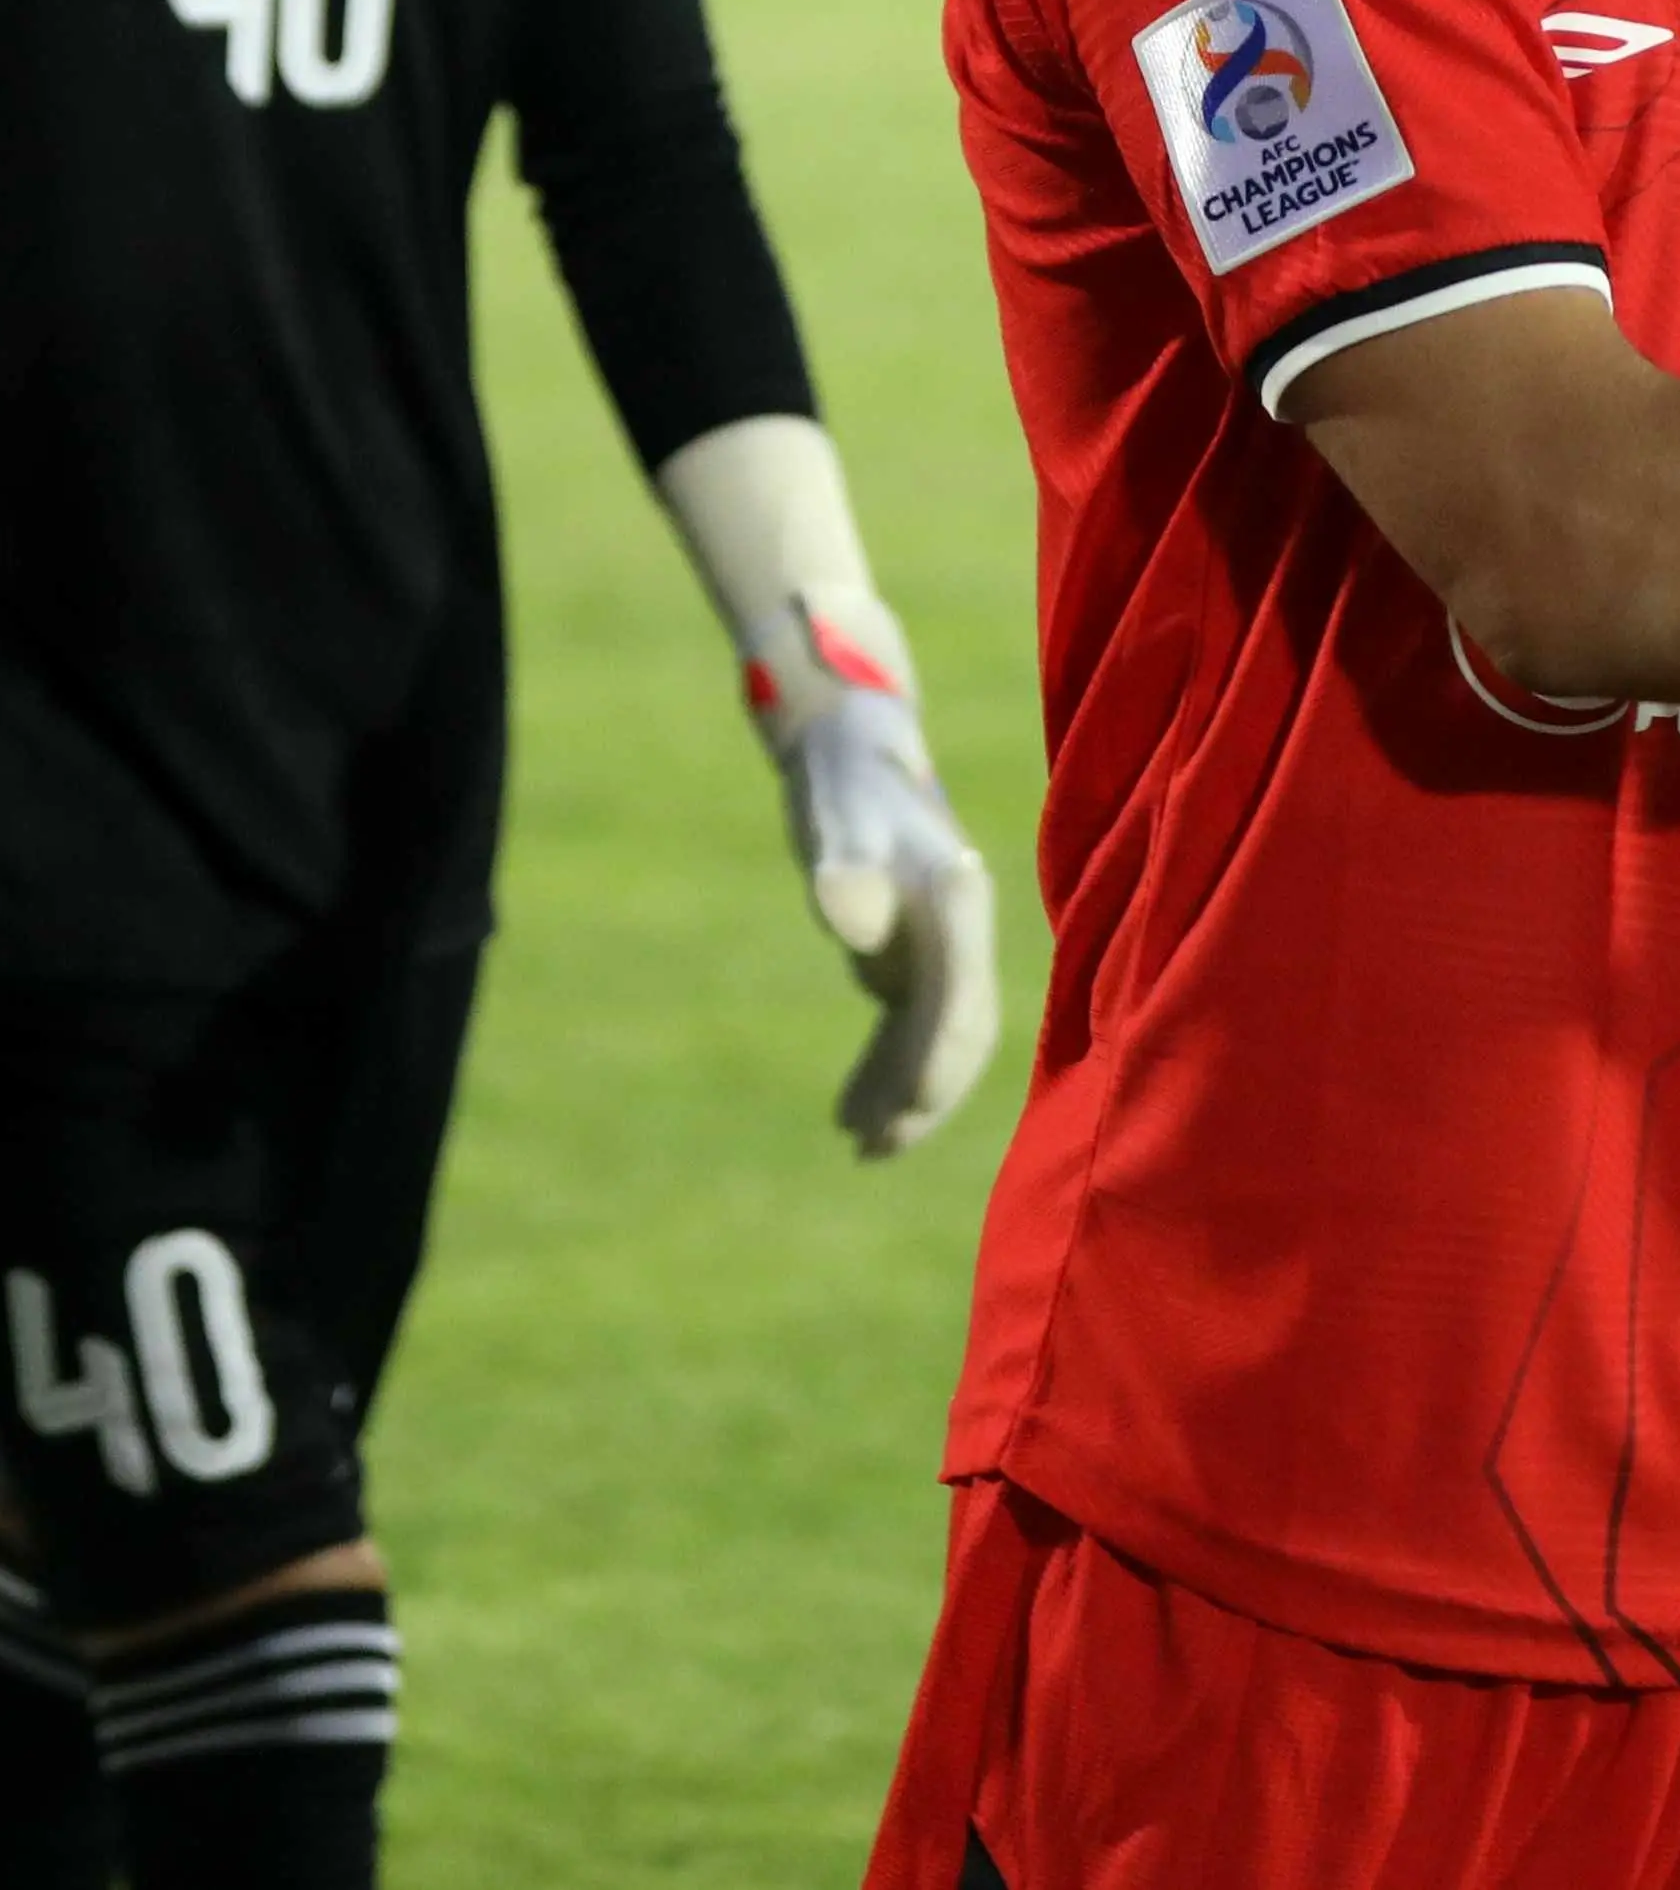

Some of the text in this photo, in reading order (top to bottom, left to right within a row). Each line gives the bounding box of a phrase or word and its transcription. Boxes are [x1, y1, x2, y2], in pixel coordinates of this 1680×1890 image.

[1203, 121, 1378, 222] CHAMPIONS
[1261, 135, 1301, 166] AFC
[5, 1226, 277, 1498] 40
